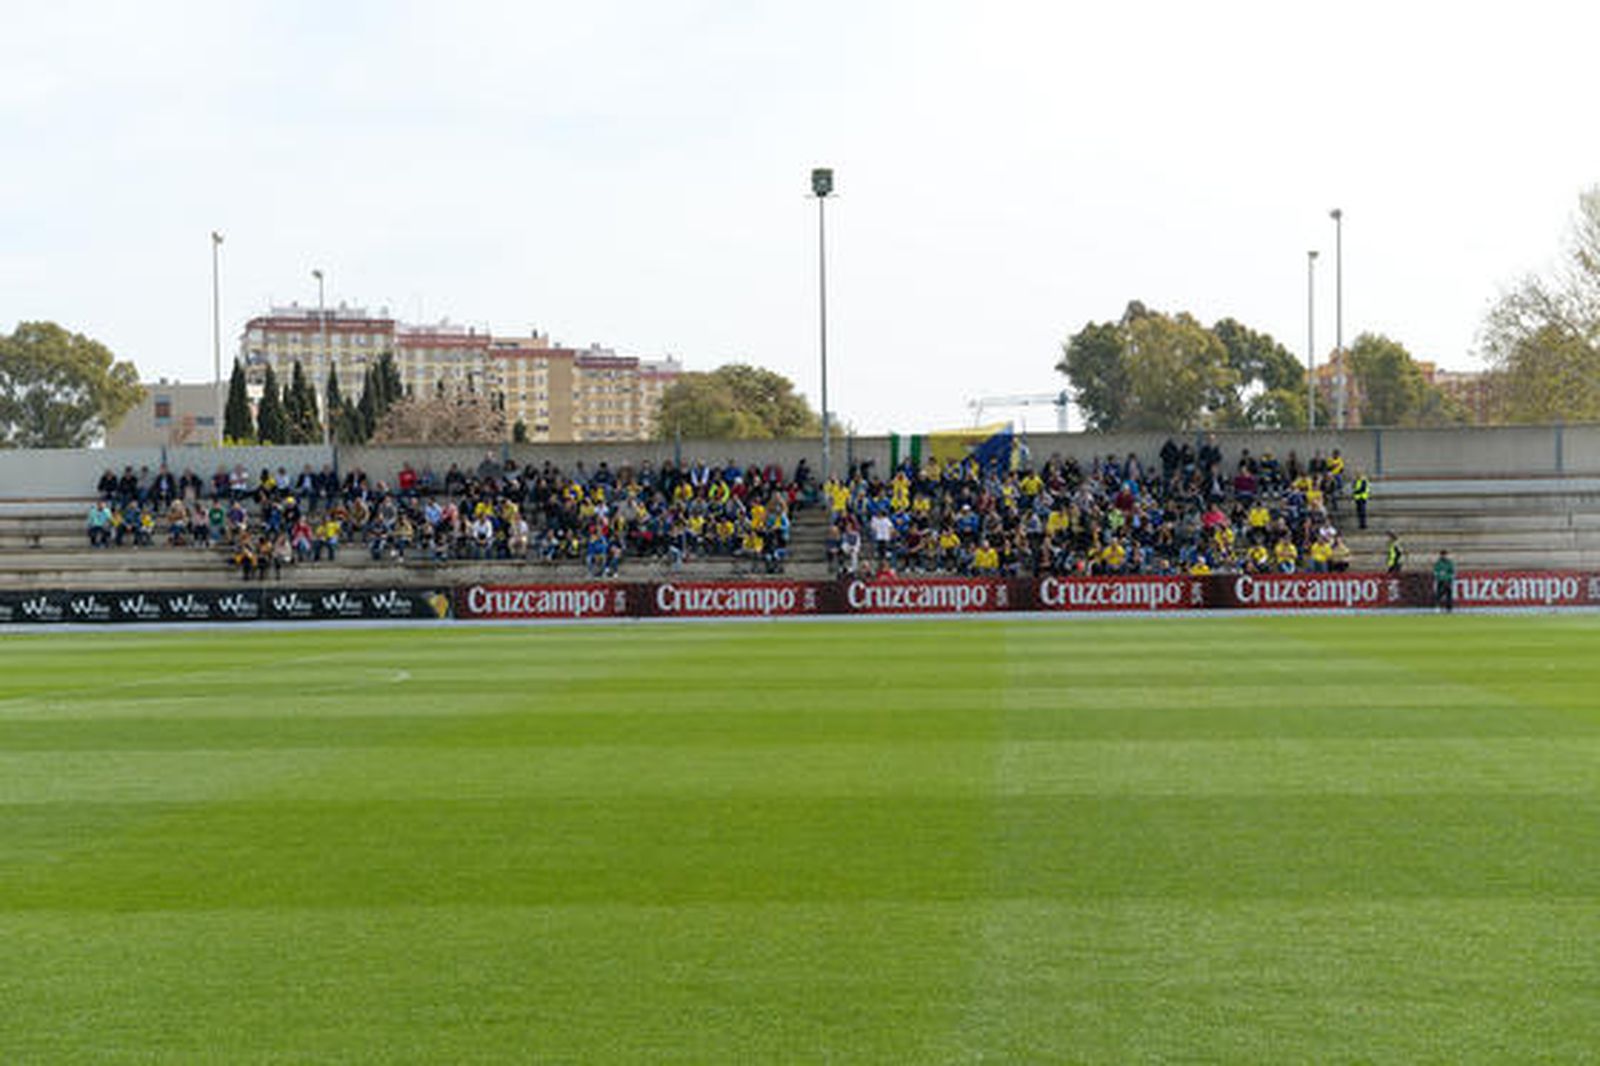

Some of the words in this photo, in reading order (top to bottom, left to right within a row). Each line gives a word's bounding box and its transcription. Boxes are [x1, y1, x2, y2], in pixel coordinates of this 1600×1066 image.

[467, 587, 606, 615] Cruzcampo
[655, 584, 794, 612] Cruzcampo
[847, 581, 987, 609] Cruzcampo
[1039, 578, 1181, 606] Cruzcampo
[1235, 576, 1378, 604] Cruzcampo
[1452, 576, 1578, 604] ruzcampo
